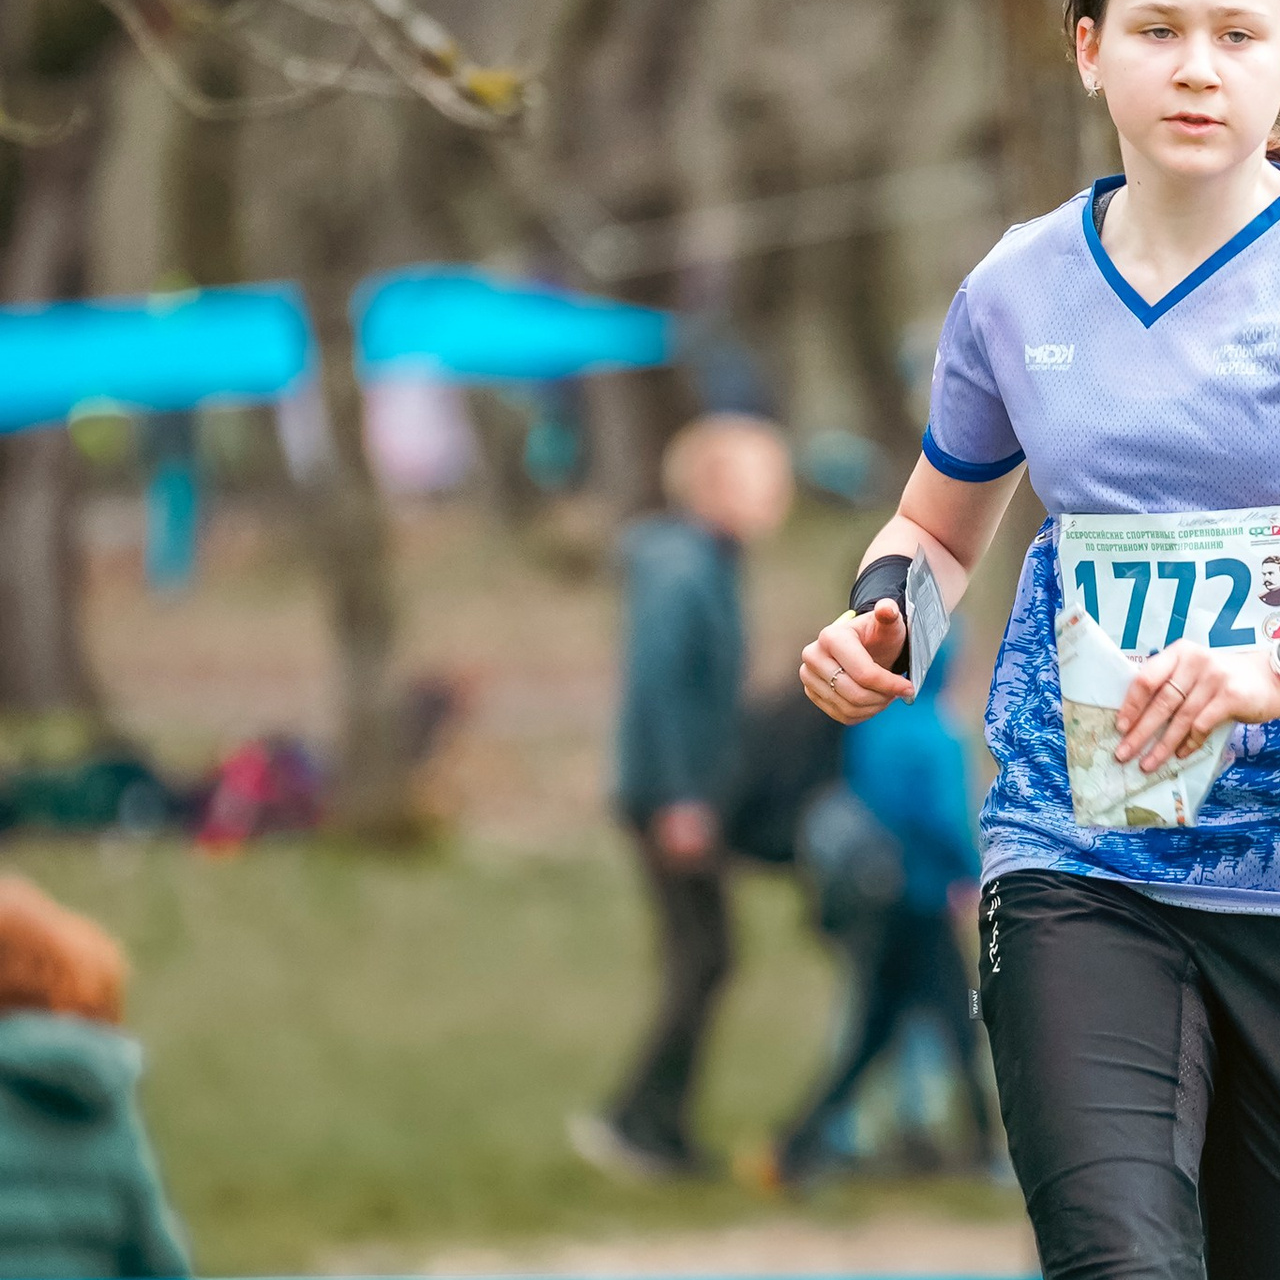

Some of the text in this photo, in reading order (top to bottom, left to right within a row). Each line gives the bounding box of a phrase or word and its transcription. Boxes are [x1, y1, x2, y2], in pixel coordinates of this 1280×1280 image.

[1066, 526, 1244, 540] ВСЕРОССИЙСКИЕ СПОРТИВНЫЕ СОРЕВНОВАНИЯ
[1085, 540, 1224, 552] ПО СПОРТИВНОМУ ОРИЕНТИРОВАНИЮ
[1074, 557, 1257, 650] 1772
